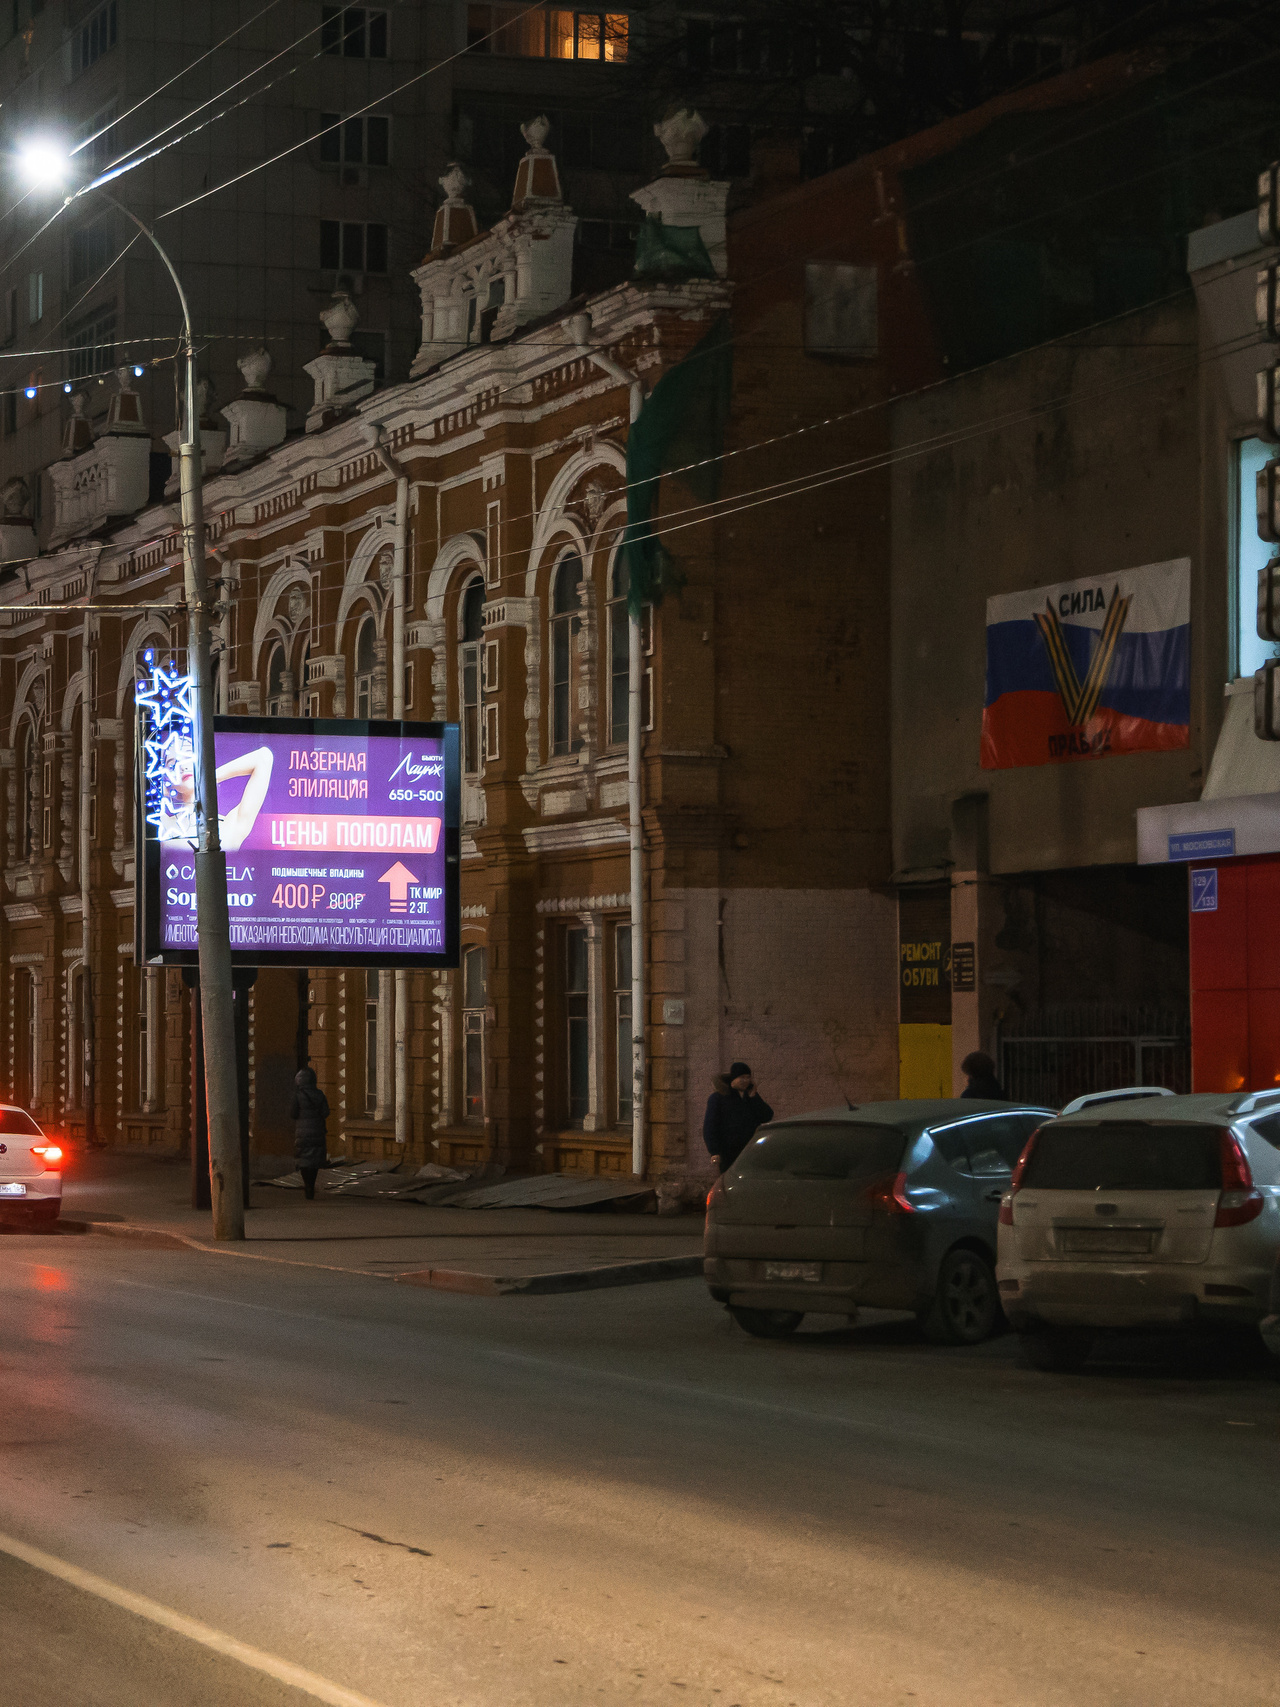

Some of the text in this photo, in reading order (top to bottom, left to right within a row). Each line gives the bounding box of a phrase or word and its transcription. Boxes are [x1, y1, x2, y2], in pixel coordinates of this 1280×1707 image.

[1059, 588, 1105, 617] СИЛА
[289, 751, 366, 772] ЛАЗЕРНАЯ
[289, 778, 368, 800] ЭПИЛЯЦИЯ
[388, 789, 443, 802] 650-500
[271, 820, 432, 848] ЦЕНЫ ПОПОЛАМ
[272, 867, 364, 879] ПОДМЫШЕЧНЫЕ ВПАДИНЫ
[409, 887, 443, 899] ТК МИР
[409, 902, 415, 913] 2
[278, 926, 329, 946] НЕОБХОДИМА
[330, 926, 388, 946] КОНСУЛЬТАЦИЯ
[389, 928, 442, 947] СПЕЦИАЛИСТА
[901, 942, 941, 961] РЕМОНТ
[903, 967, 939, 986] ОБУВИ
